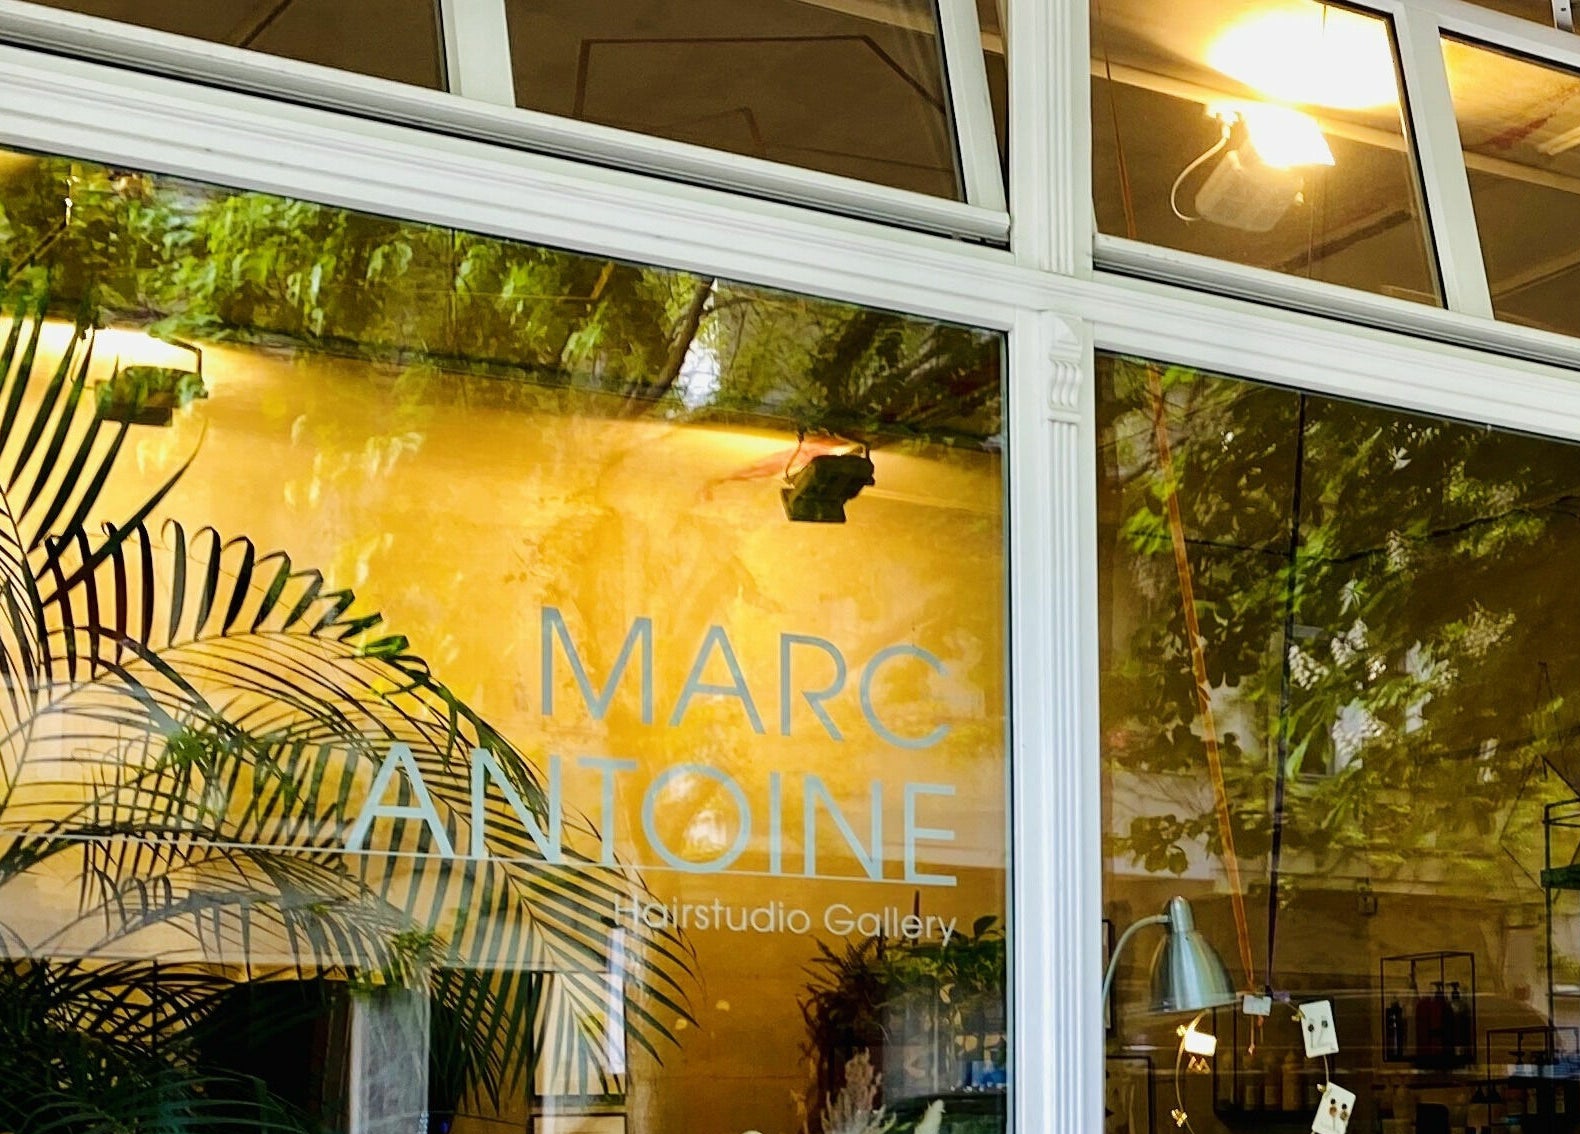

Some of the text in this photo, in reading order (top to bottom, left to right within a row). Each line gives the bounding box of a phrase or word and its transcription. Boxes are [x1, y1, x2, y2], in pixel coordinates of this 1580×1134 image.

[540, 605, 951, 750] MARC
[344, 741, 957, 887] ANTOINE
[613, 893, 958, 946] Hairstudio Gallery
